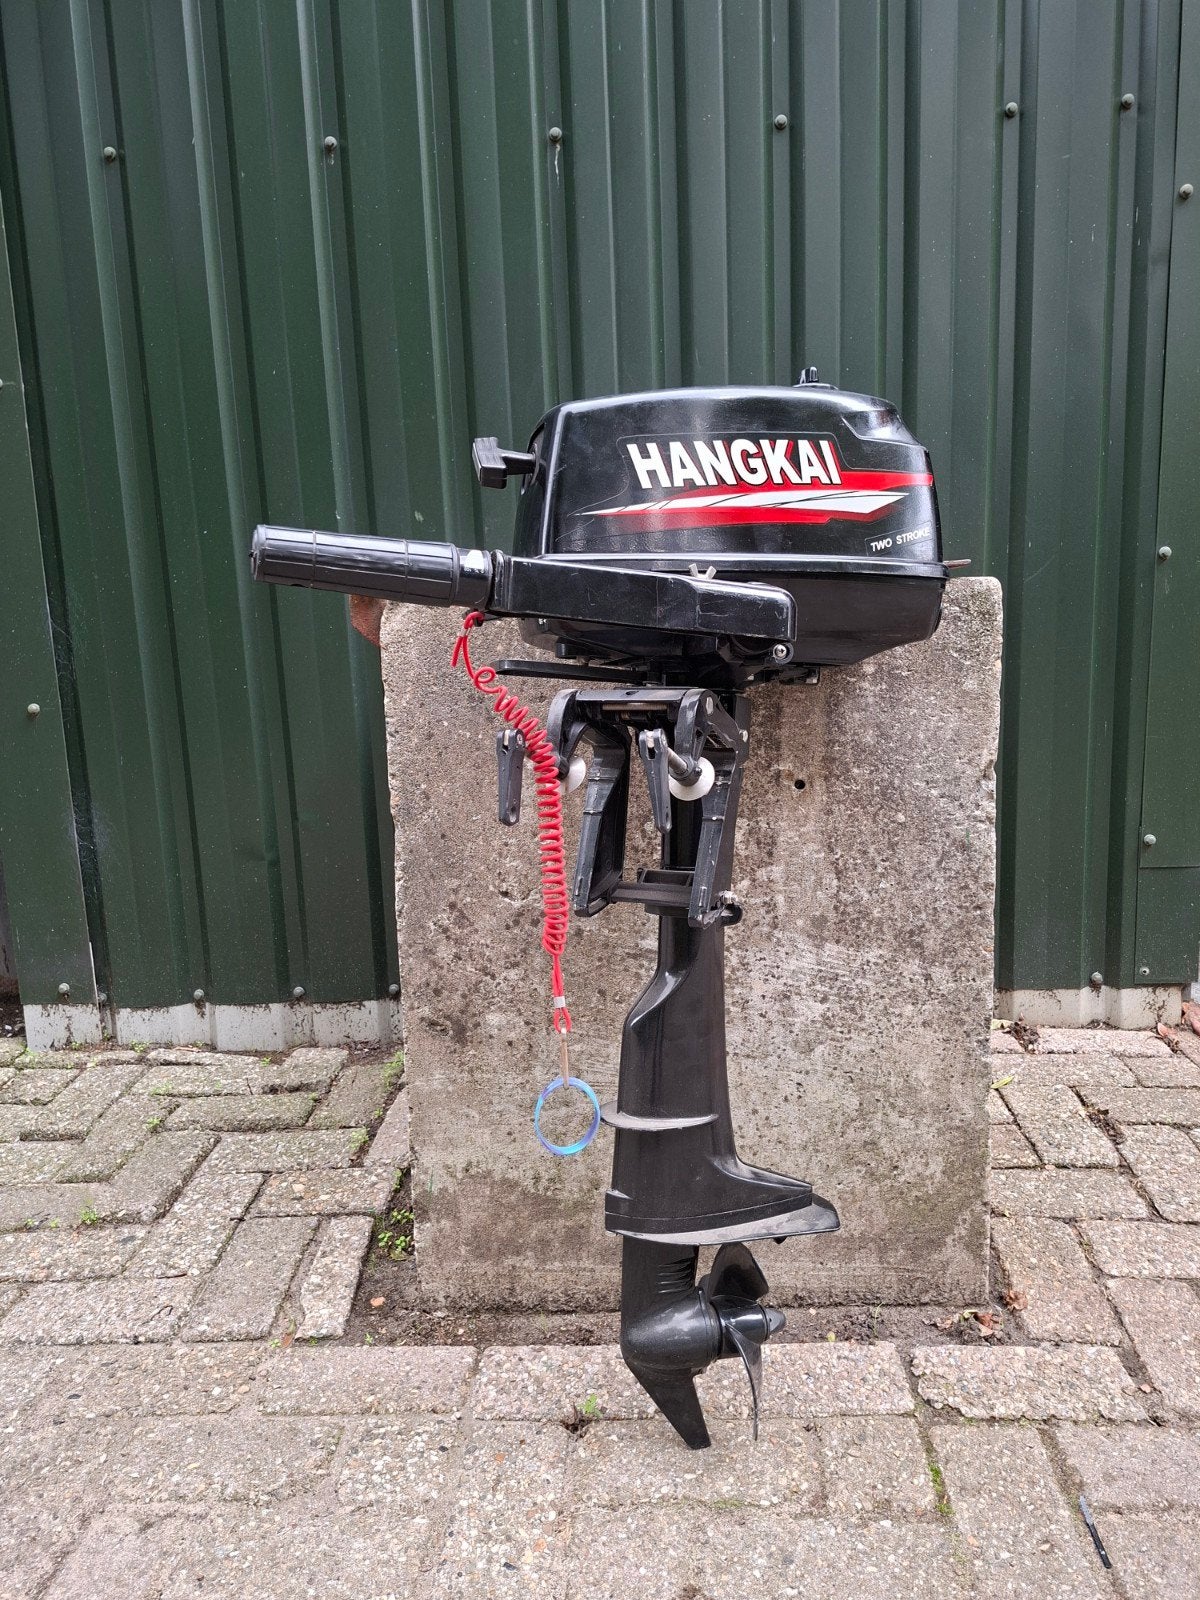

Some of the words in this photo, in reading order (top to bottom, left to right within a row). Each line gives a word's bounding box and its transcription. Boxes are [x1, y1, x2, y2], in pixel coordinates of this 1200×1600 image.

[626, 438, 842, 489] HANGKAI
[870, 538, 892, 552] TWO
[896, 527, 930, 544] STROKE
